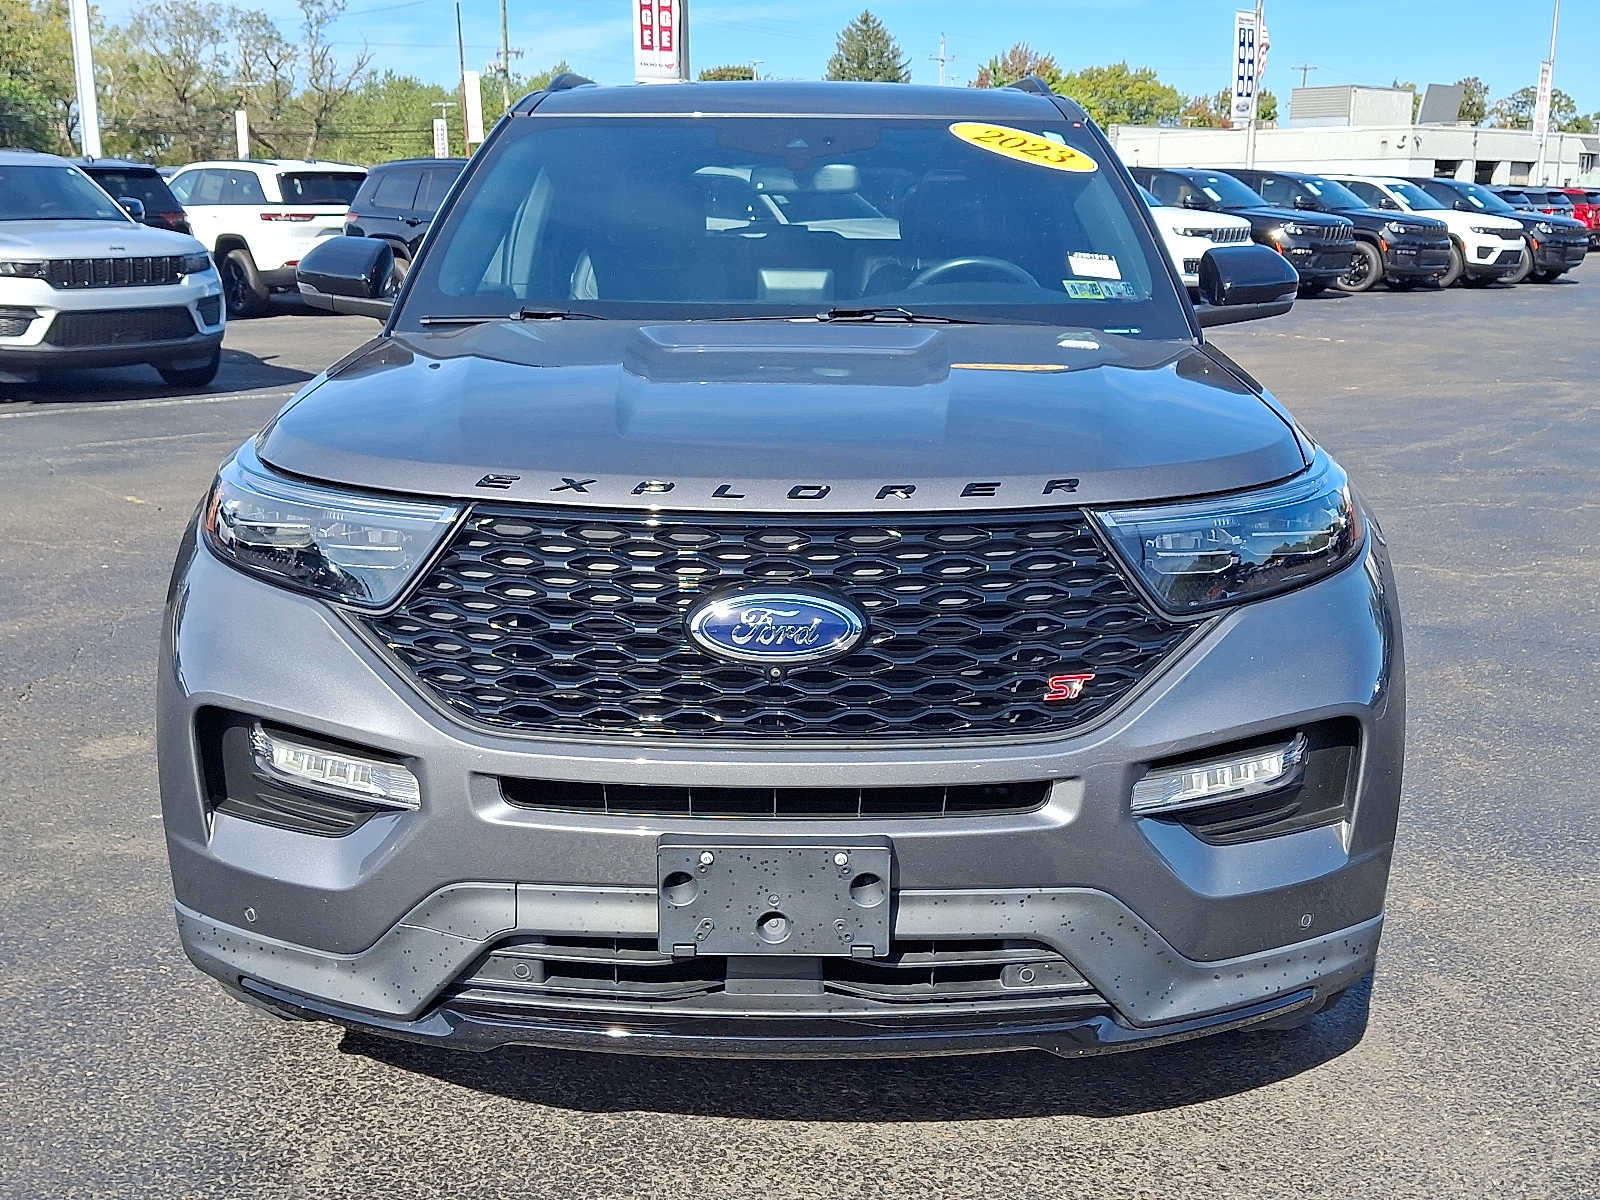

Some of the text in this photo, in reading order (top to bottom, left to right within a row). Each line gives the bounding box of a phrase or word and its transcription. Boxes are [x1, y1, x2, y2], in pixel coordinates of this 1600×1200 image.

[974, 130, 1076, 163] 2023
[474, 473, 1081, 501] EXPLORER
[731, 607, 824, 646] Ford
[1043, 673, 1096, 701] ST
